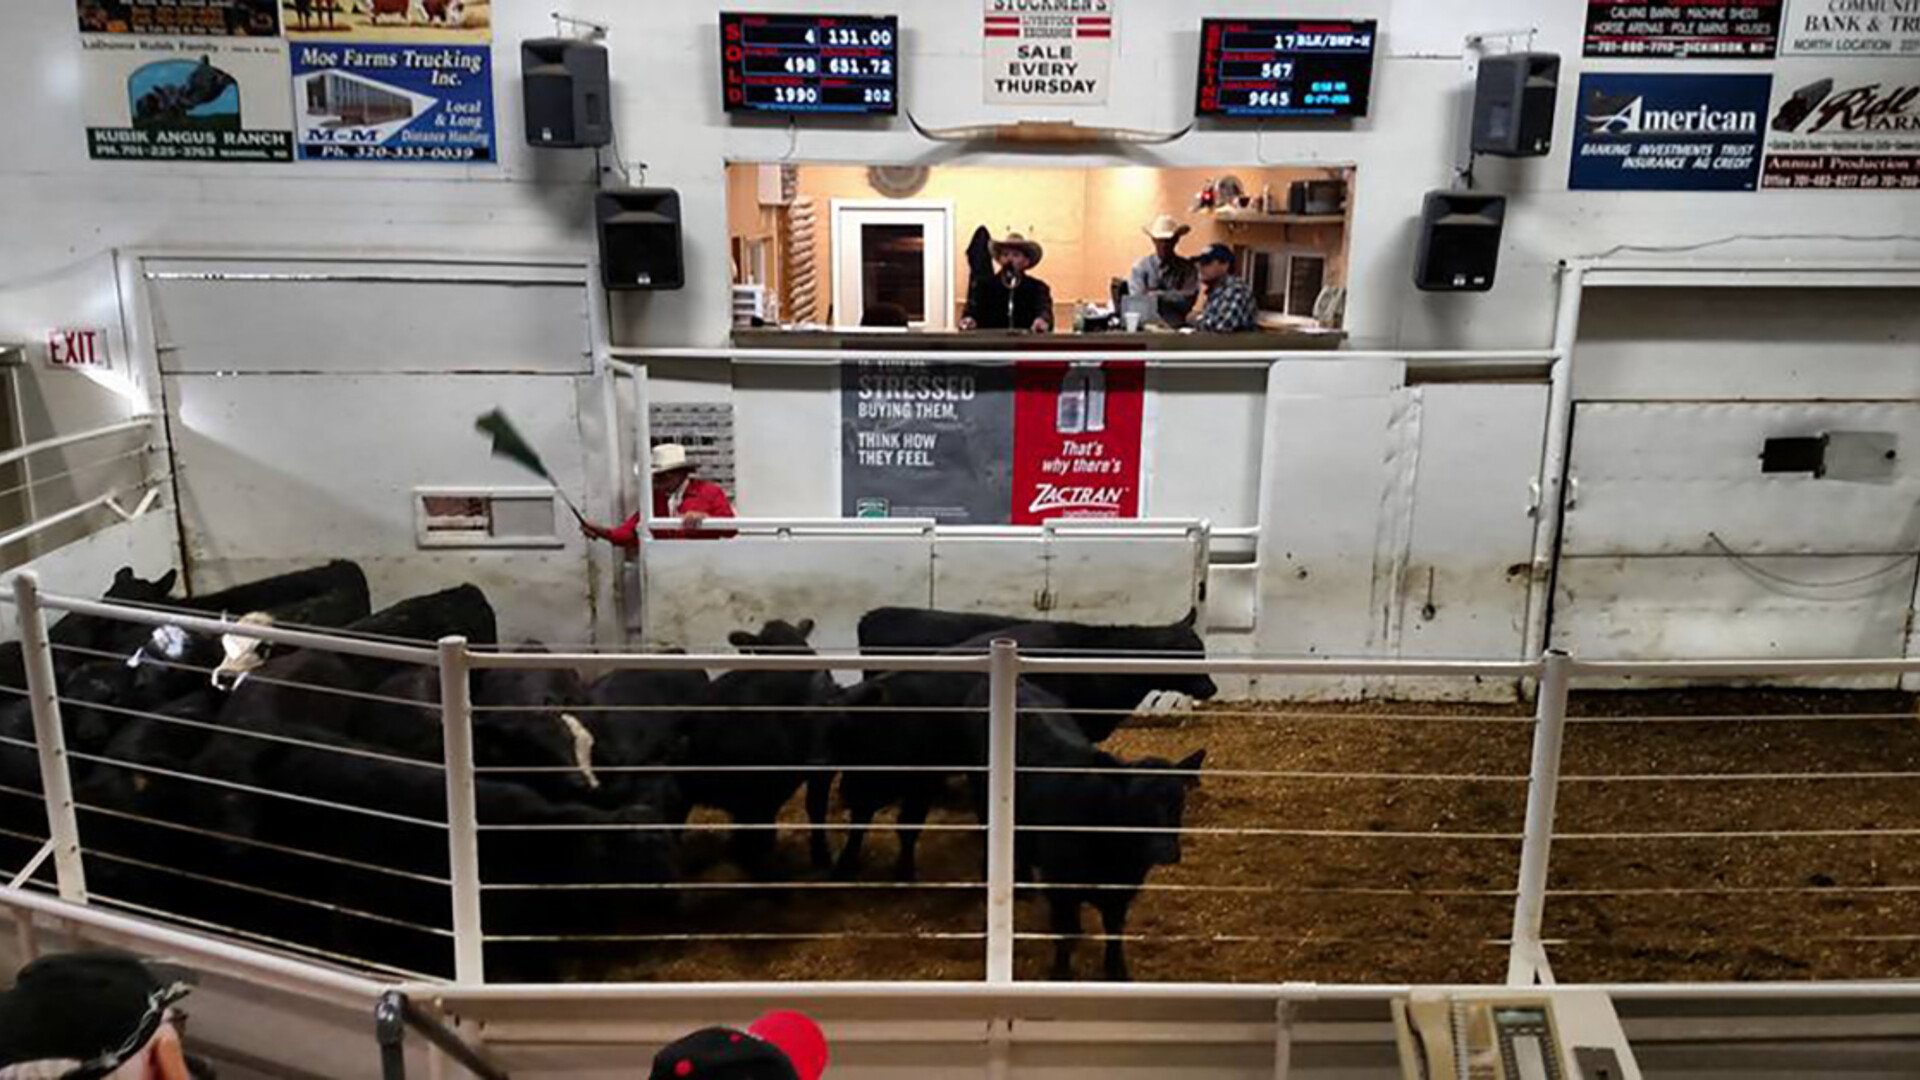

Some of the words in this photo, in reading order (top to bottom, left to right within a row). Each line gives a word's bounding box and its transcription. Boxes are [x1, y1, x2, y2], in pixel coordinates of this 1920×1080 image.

[1805, 15, 1860, 32] BANK
[1867, 17, 1880, 32] &
[804, 29, 815, 44] 4
[828, 29, 892, 45] 131.00
[1274, 35, 1295, 49] 17
[1836, 39, 1892, 51] LOCATION
[1018, 45, 1072, 59] SALE
[301, 48, 338, 65] Moe
[344, 49, 398, 67] Farms
[403, 49, 482, 73] Trucking
[784, 57, 816, 73] 498
[1009, 62, 1078, 76] EVERY
[1261, 63, 1293, 78] 567
[431, 70, 462, 86] Inc.
[775, 87, 817, 102] 1990
[994, 79, 1096, 94] THURSDAY
[446, 100, 482, 113] Local
[1249, 92, 1290, 106] 9645
[1587, 95, 1757, 133] American
[434, 115, 447, 127] &
[450, 115, 483, 130] Long
[94, 130, 150, 143] KUBIK
[156, 131, 216, 144] ANGUS
[223, 132, 286, 146] RANCH
[1580, 144, 1632, 156] BANKING
[1637, 144, 1714, 156] INVESTMENTS
[1720, 144, 1756, 156] TRUST
[1621, 157, 1687, 169] INSURANCE
[1692, 157, 1710, 169] AG
[1712, 157, 1754, 169] CREDIT
[1768, 157, 1824, 169] Annual
[1829, 157, 1909, 170] Production
[50, 331, 95, 364] EXIT
[858, 375, 976, 400] STRESSED
[858, 402, 912, 419] BUYING
[915, 402, 959, 420] THEM,
[858, 432, 900, 448] THINK
[903, 432, 937, 449] HOW
[1062, 440, 1104, 456] That's
[858, 449, 894, 465] THEY
[1042, 457, 1071, 475] why
[1073, 457, 1122, 473] there's
[1029, 483, 1123, 513] ZACTRAN
